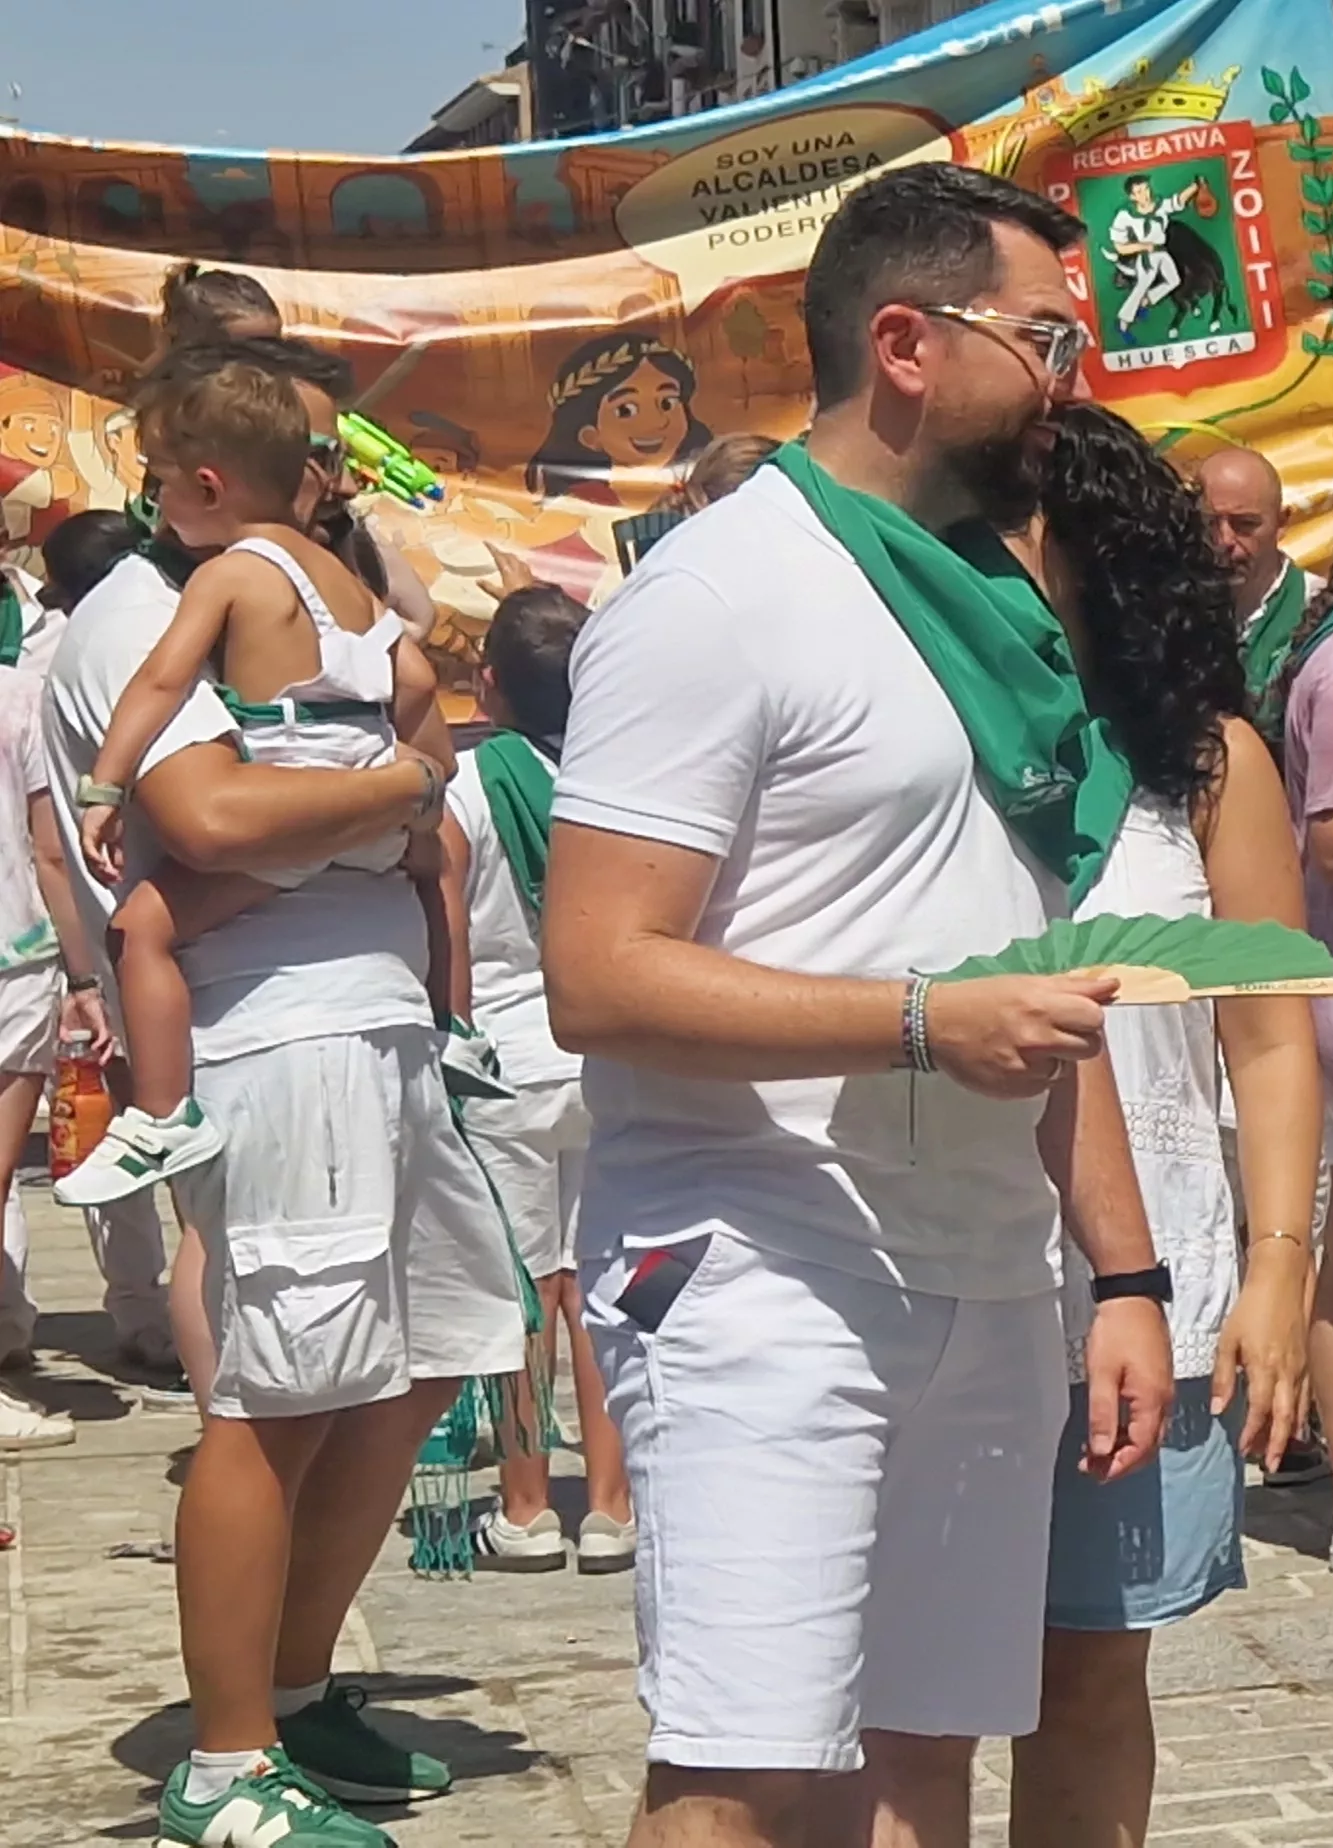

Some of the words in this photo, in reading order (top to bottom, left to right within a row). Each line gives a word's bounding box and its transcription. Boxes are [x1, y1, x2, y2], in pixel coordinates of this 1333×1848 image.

[715, 144, 780, 171] SOY
[791, 131, 857, 157] UNA
[1072, 127, 1227, 171] RECREATIVA
[691, 151, 885, 198] ALCALDESA
[1231, 149, 1274, 330] ZOITI
[1116, 338, 1244, 369] HUESCA
